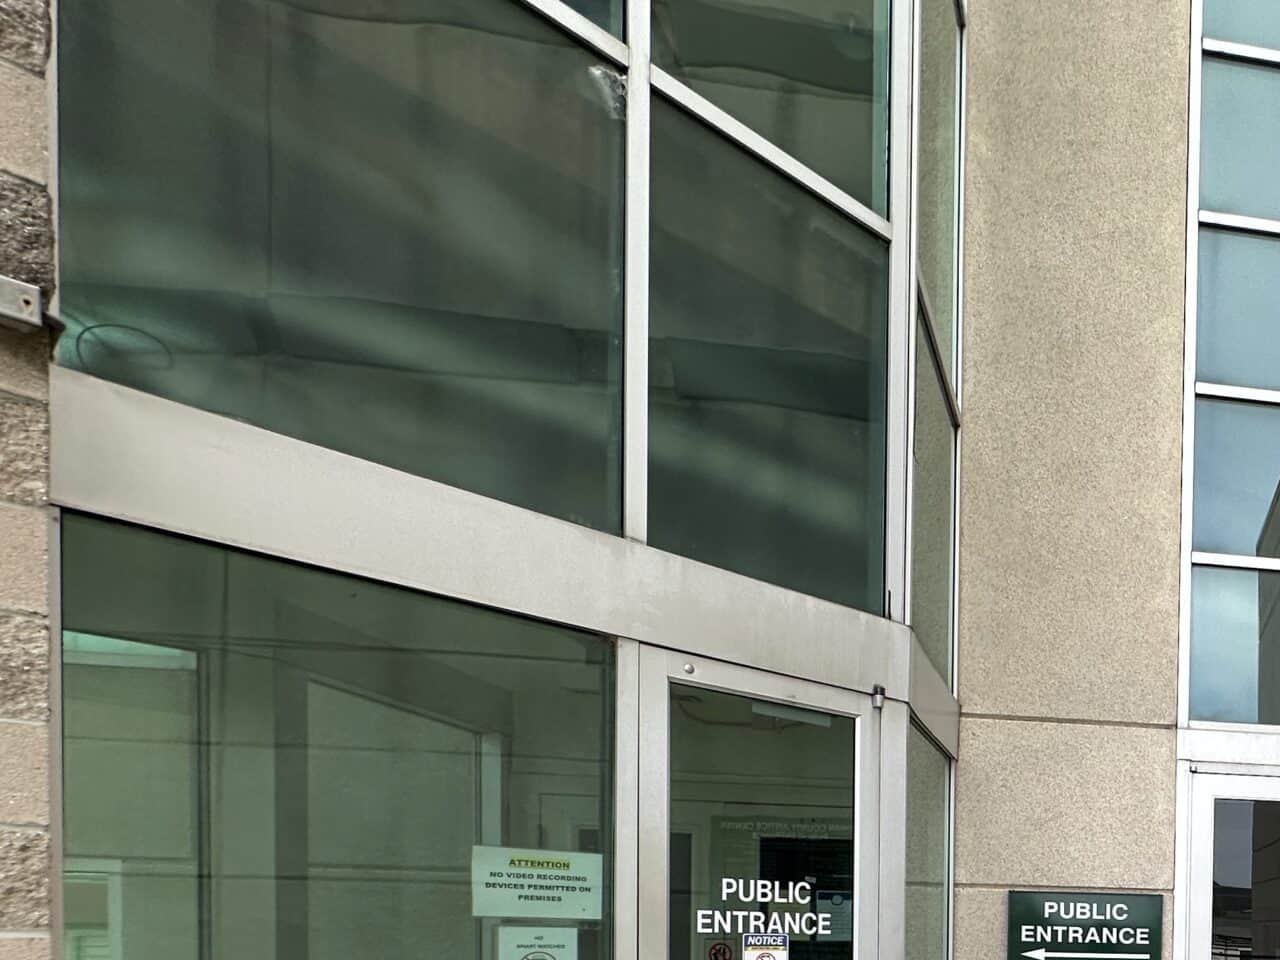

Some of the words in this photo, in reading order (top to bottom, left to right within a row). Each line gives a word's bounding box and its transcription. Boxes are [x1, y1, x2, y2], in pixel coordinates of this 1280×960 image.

[509, 859, 570, 869] ATTENTION
[536, 874, 587, 882] RECORDING
[485, 882, 525, 890] DEVICES
[528, 884, 576, 892] PERMITTED
[722, 878, 811, 905] PUBLIC
[1044, 902, 1128, 920] PUBLIC
[696, 910, 831, 935] ENTRANCE
[747, 936, 784, 945] NOTICE
[1021, 925, 1150, 944] ENTRANCE
